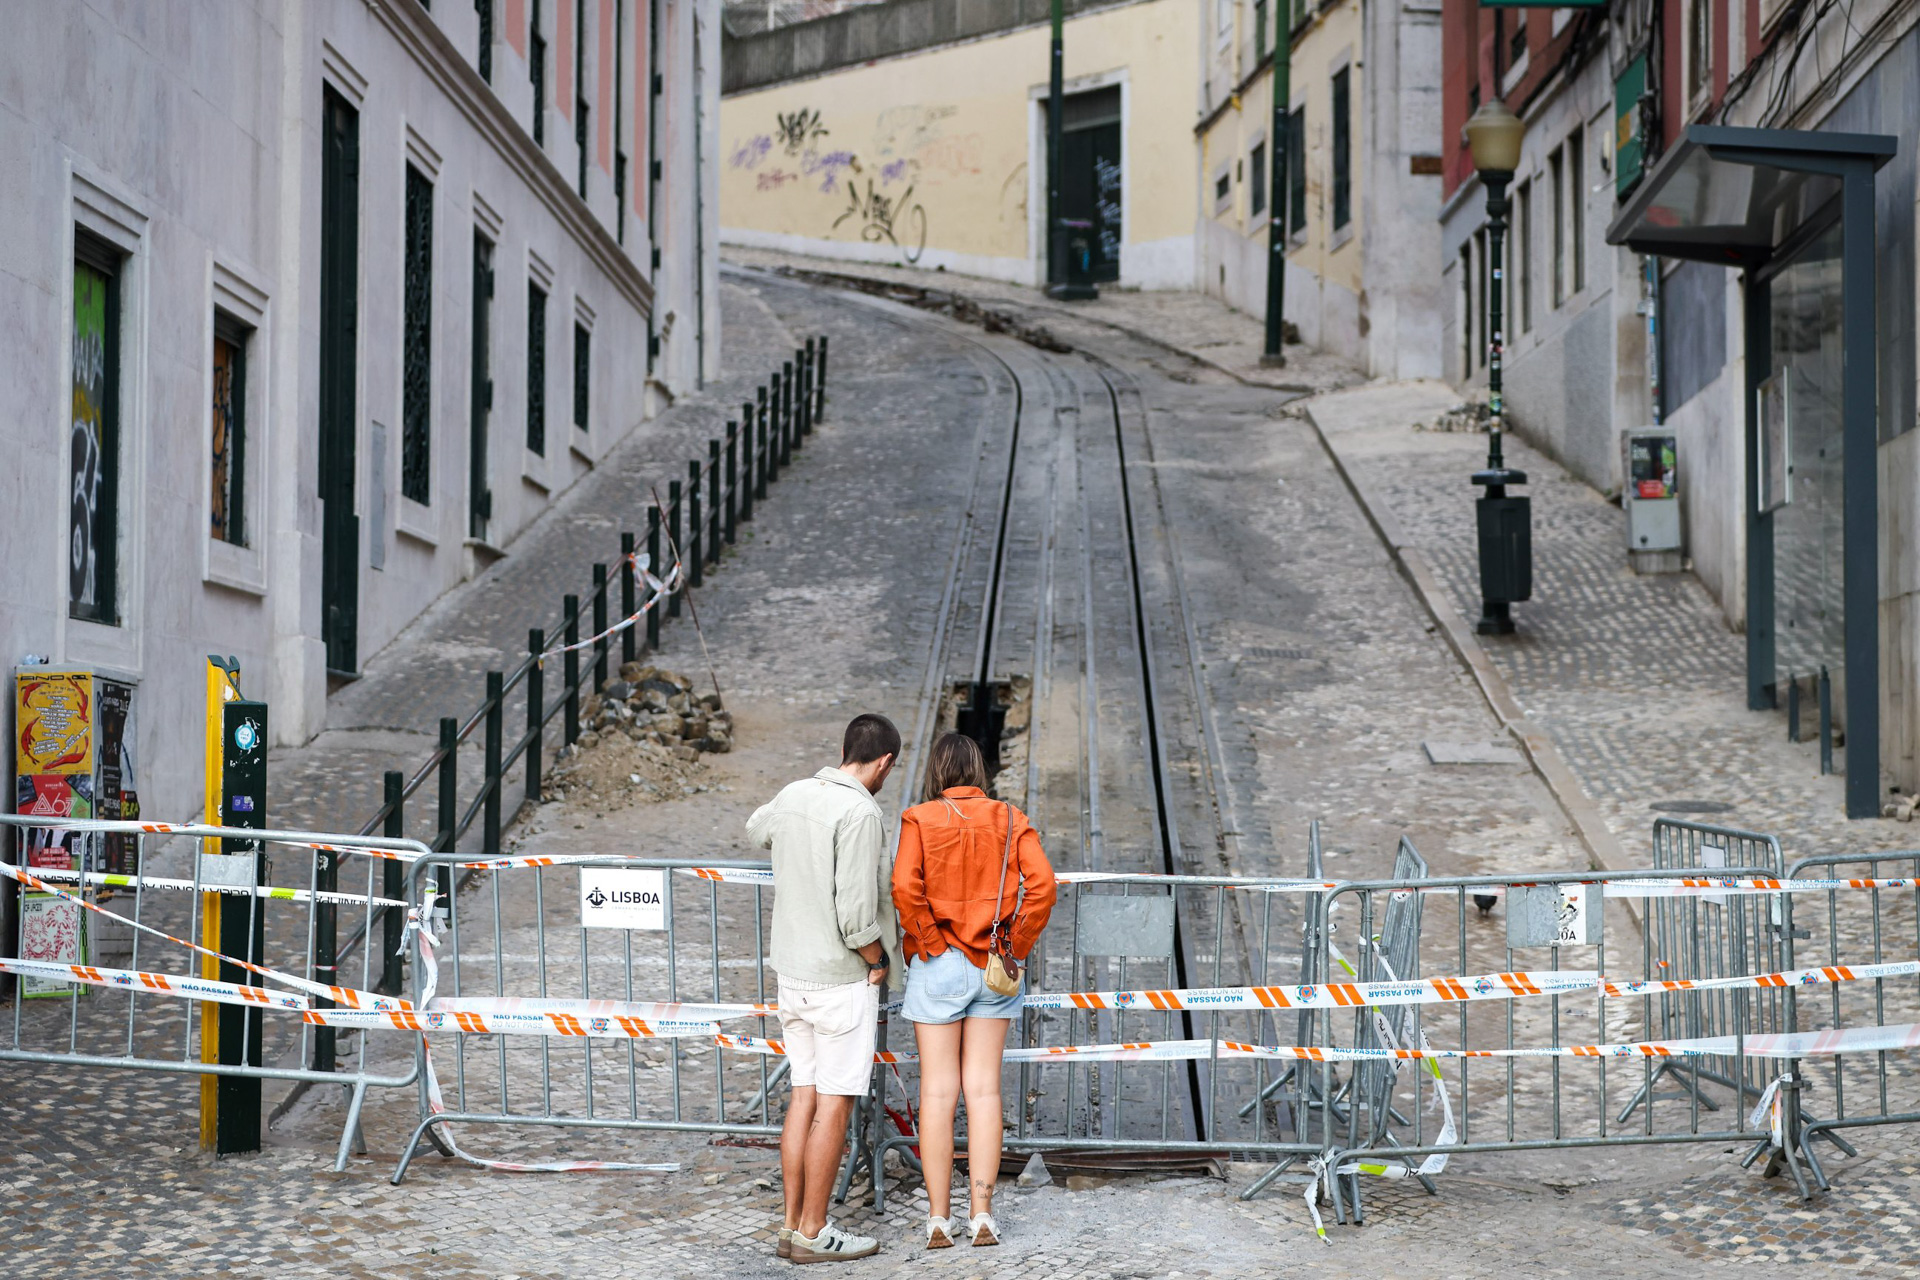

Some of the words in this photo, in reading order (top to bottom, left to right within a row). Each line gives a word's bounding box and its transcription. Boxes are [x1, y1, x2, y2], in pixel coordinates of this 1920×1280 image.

[612, 891, 660, 904] LISBOA
[202, 986, 233, 995] PASSAR
[1368, 990, 1402, 998] PASSAR
[1405, 988, 1422, 996] NÃO
[1224, 995, 1243, 1003] NÃO
